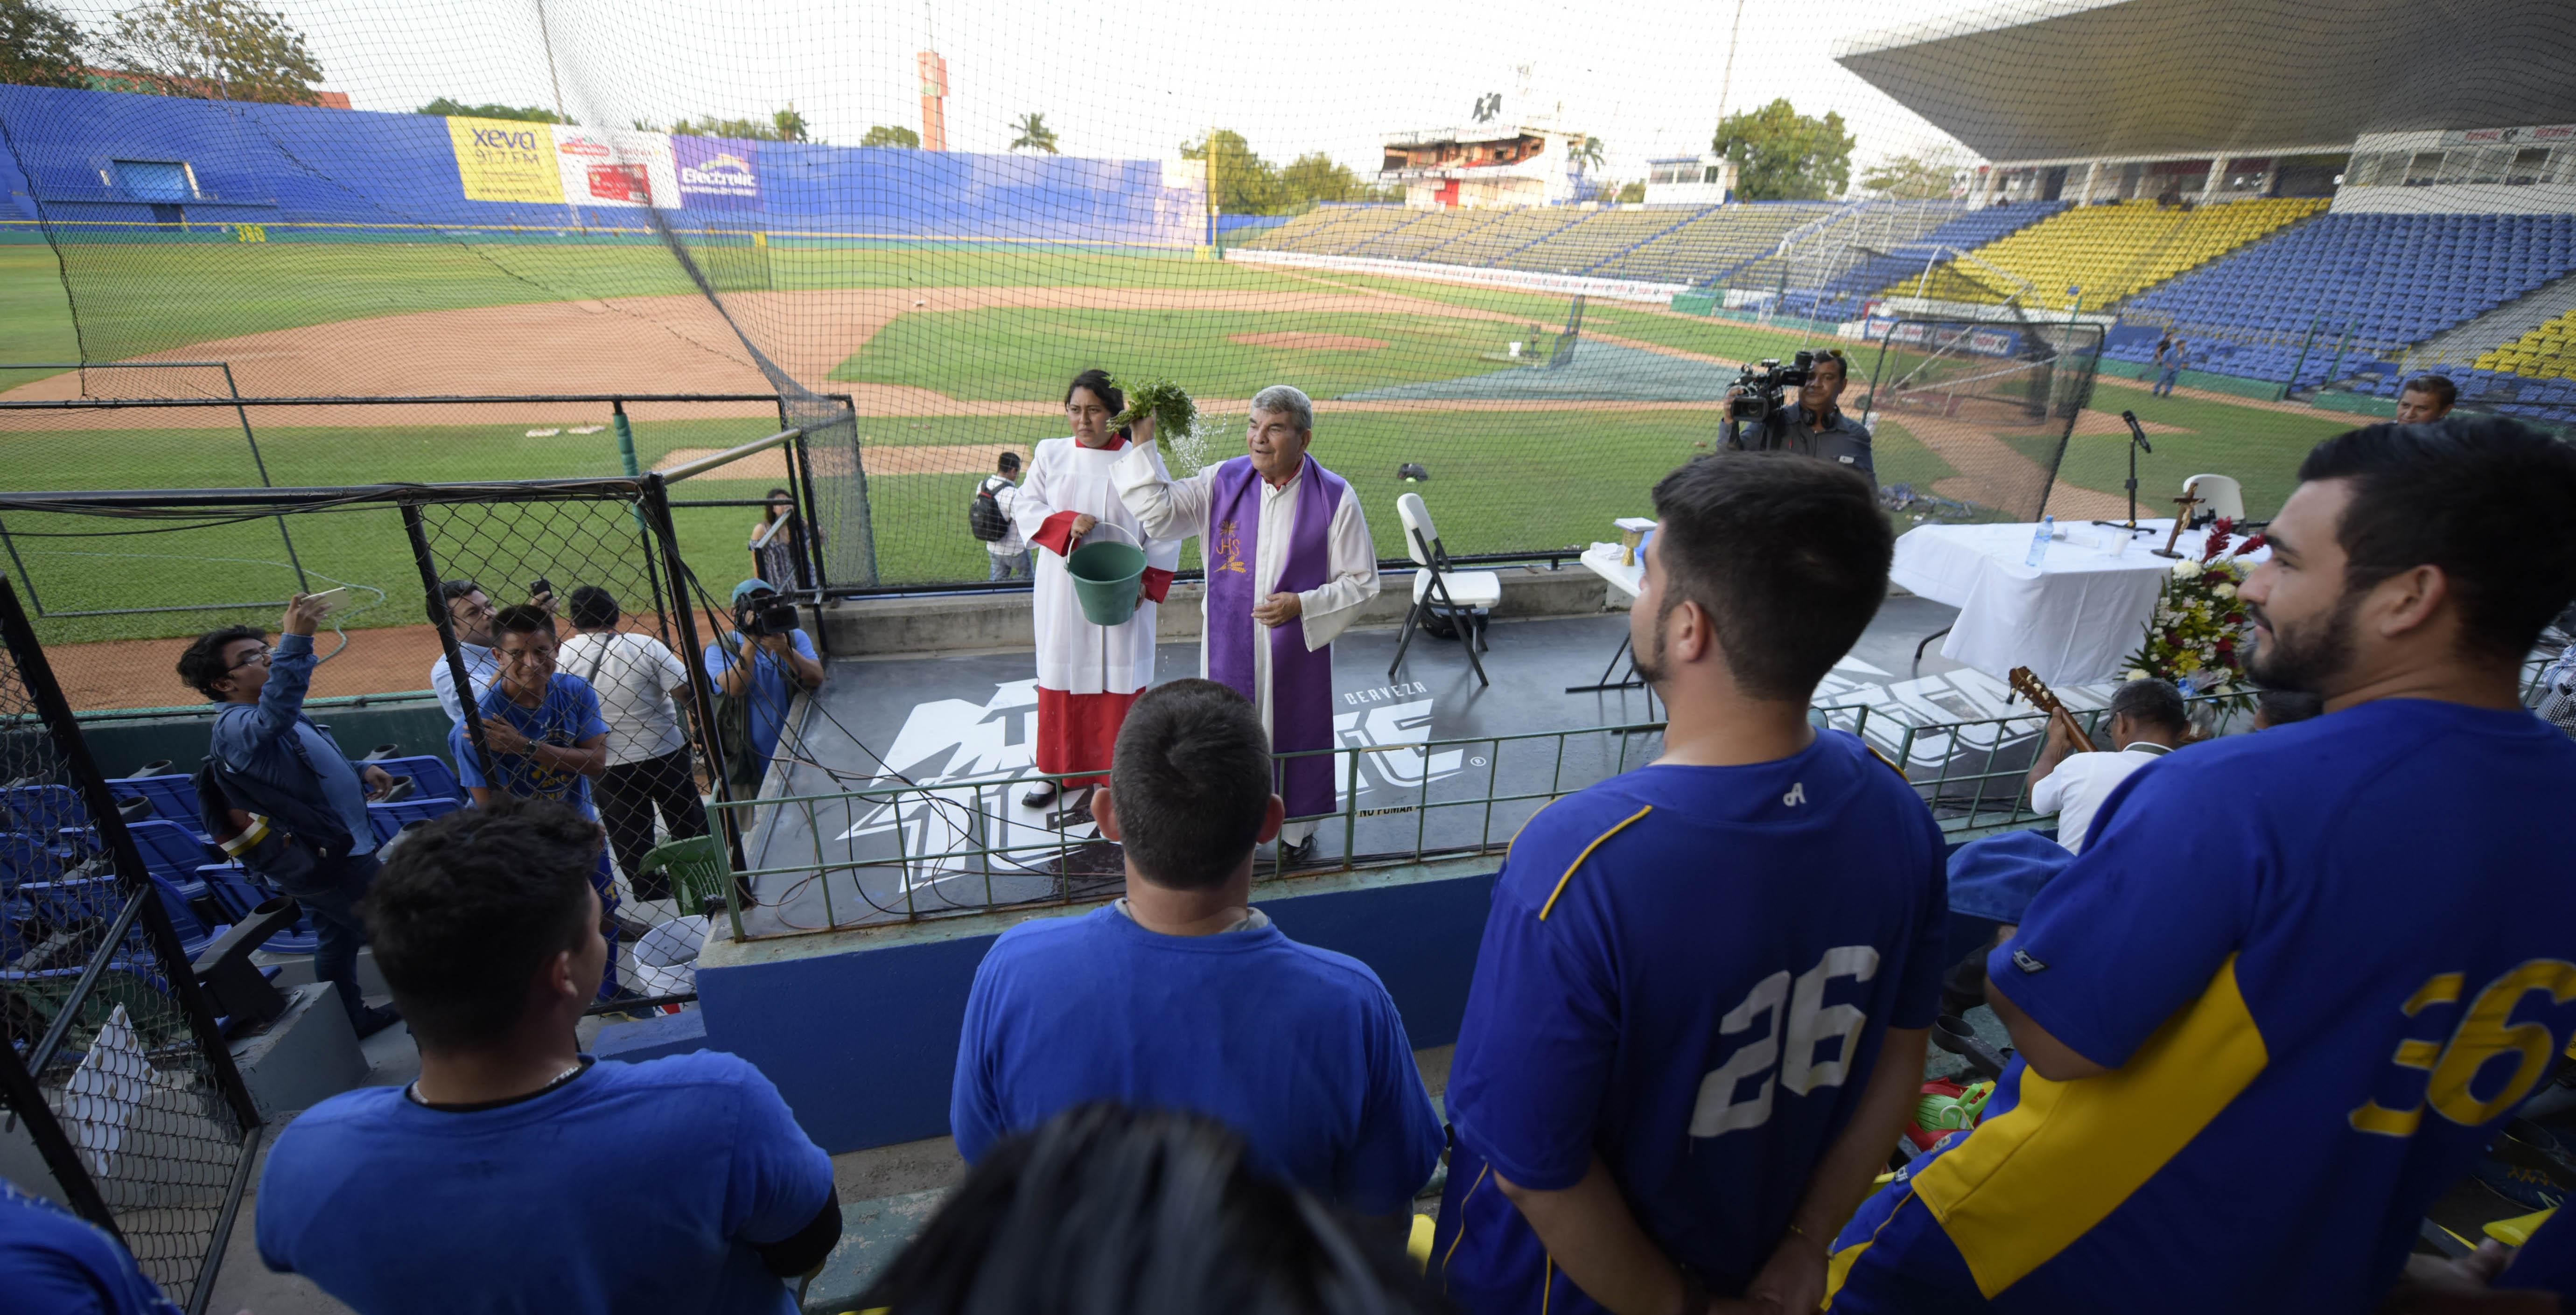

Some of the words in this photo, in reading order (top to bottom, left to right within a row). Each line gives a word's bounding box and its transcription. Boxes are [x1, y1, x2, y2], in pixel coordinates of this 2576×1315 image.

[472, 127, 536, 150] xeva
[513, 151, 540, 165] FM
[1344, 681, 1428, 705] CERVEZA
[1687, 944, 1881, 1138] 26
